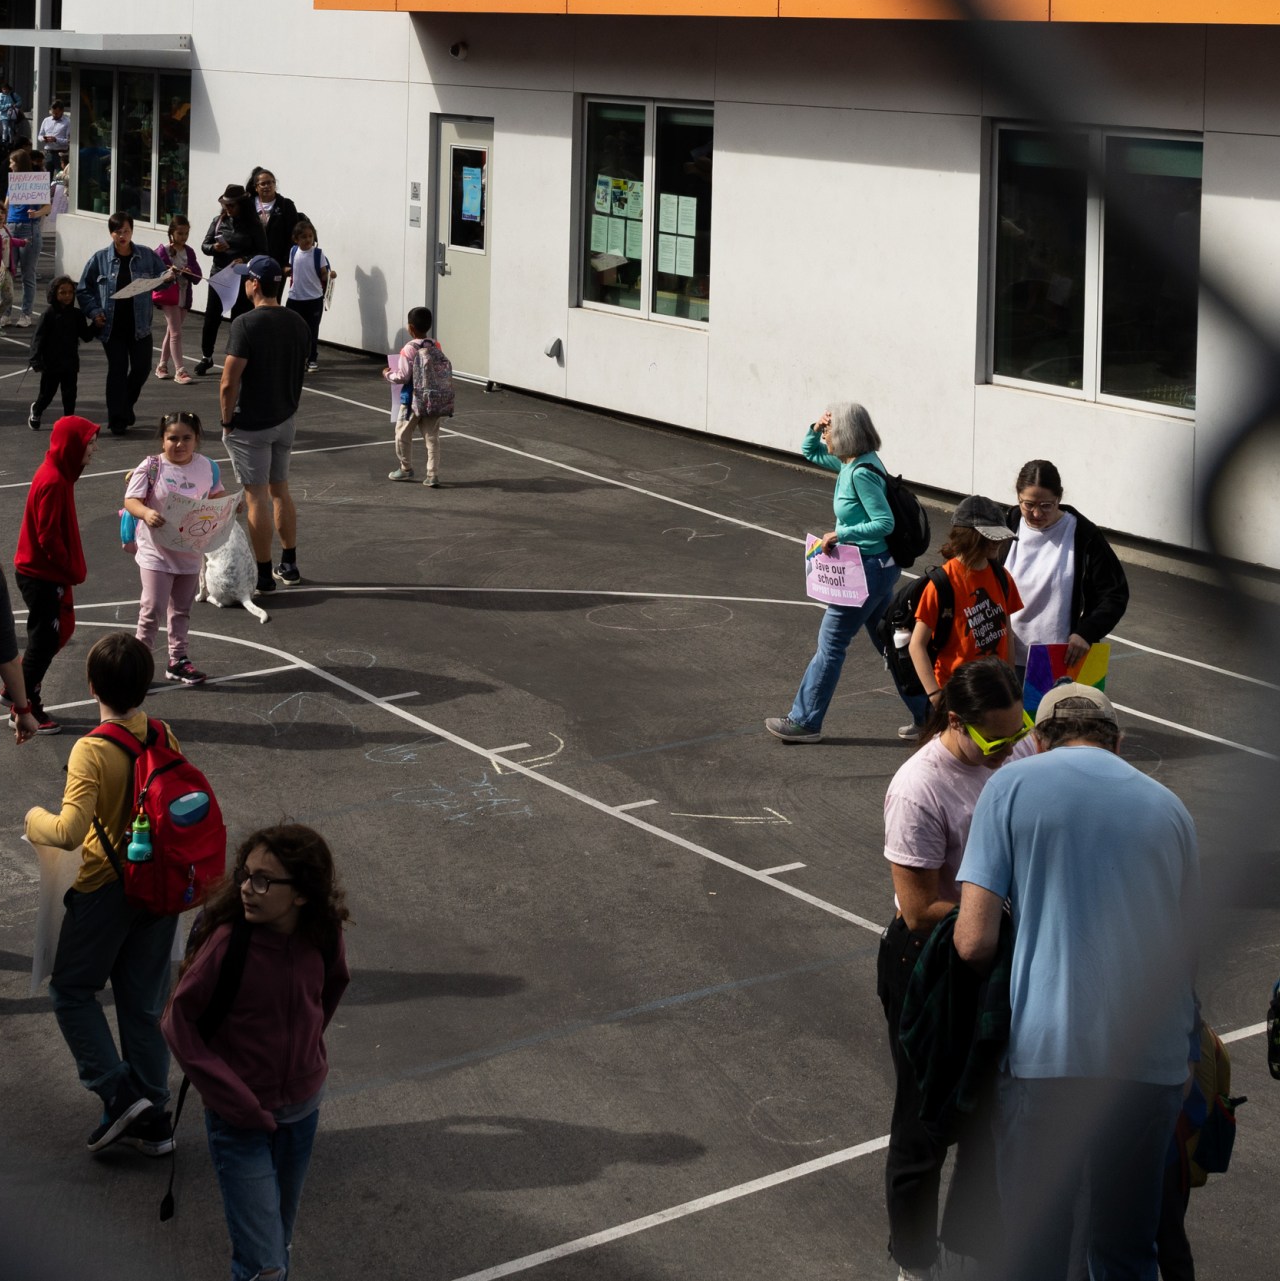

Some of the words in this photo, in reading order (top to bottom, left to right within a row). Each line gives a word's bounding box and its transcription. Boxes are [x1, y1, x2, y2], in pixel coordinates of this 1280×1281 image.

[9, 174, 32, 182] HARVEY
[9, 182, 29, 191] CIVIL
[10, 191, 49, 201] ACADEMY
[815, 559, 829, 573] Save
[831, 565, 846, 575] our
[818, 574, 846, 587] school!
[963, 599, 990, 617] Harvey
[968, 612, 986, 628] Milk
[985, 603, 1004, 619] Civil
[971, 622, 994, 639] Rights
